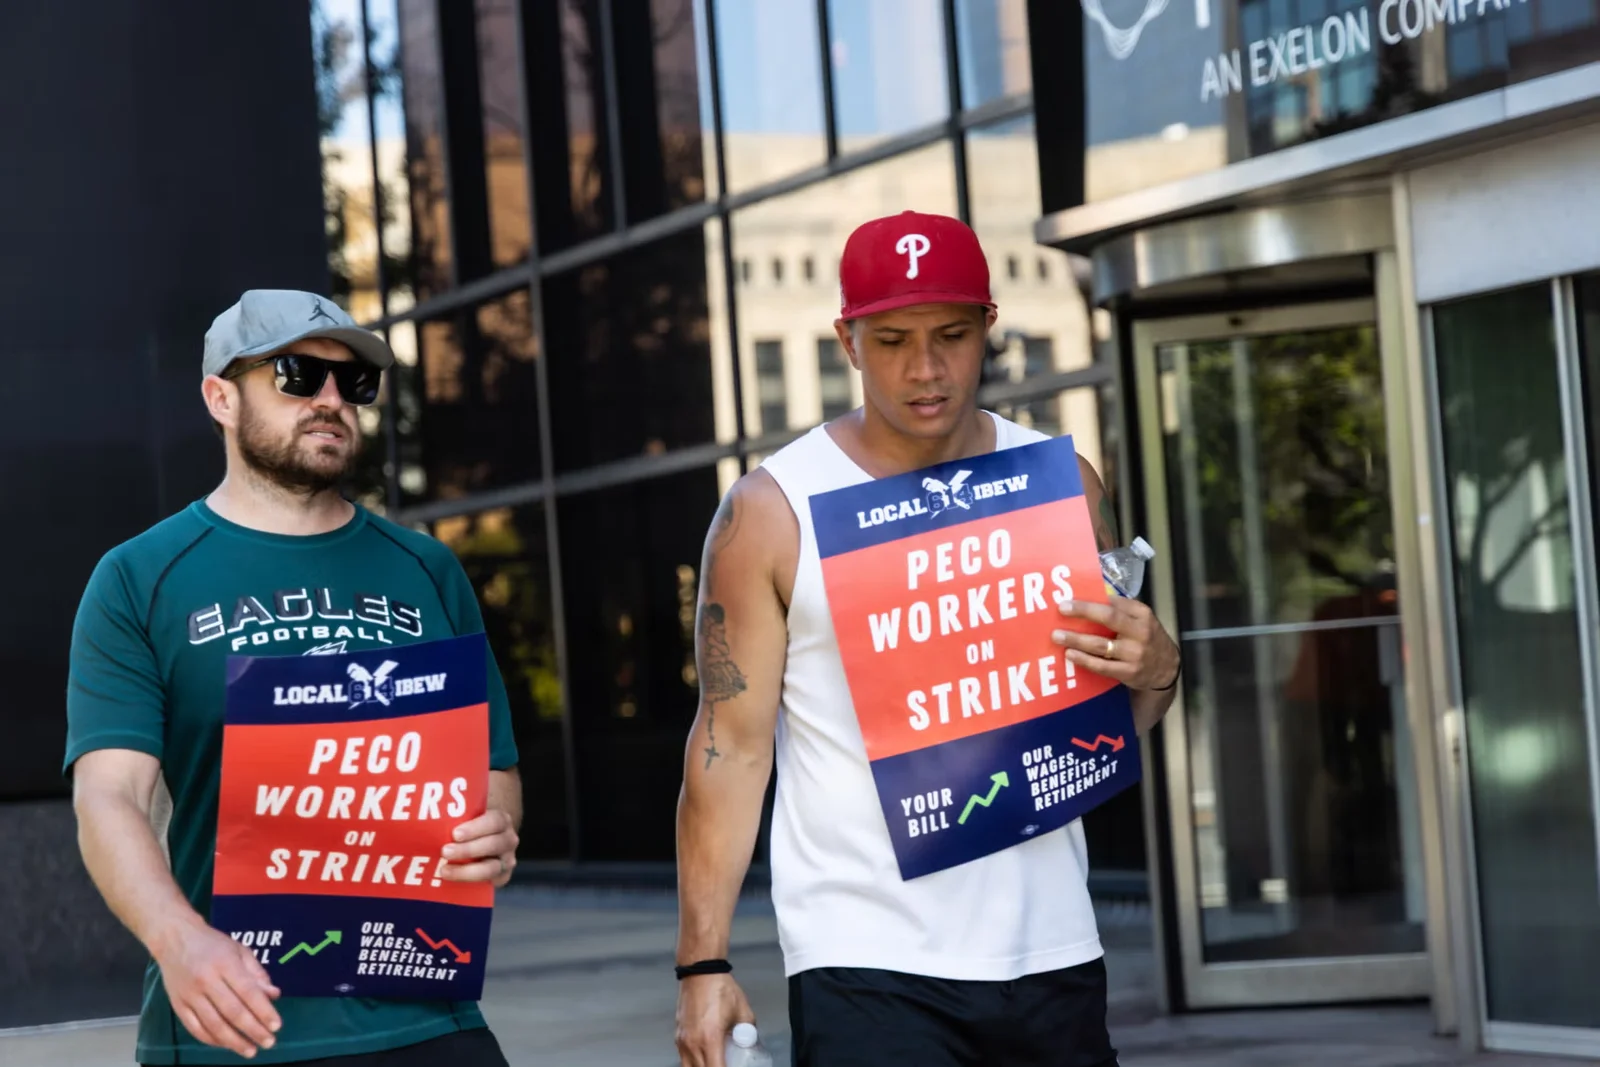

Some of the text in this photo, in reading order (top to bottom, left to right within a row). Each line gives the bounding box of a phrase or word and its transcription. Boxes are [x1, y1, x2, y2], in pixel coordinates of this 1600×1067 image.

[1200, 48, 1242, 102] AN
[1250, 11, 1371, 88] EXELON
[895, 233, 931, 280] P
[857, 497, 929, 529] LOCAL
[972, 474, 1029, 501] IBEW
[907, 528, 1012, 590] PECO
[187, 588, 423, 645] EAGLES
[868, 564, 1075, 653] WORKERS
[231, 626, 393, 651] FOOTBALL
[966, 639, 995, 664] ON
[273, 684, 349, 705] LOCAL
[394, 672, 447, 697] IBEW
[907, 655, 1078, 731] STRIKE!
[308, 732, 422, 775] PECO
[1022, 745, 1054, 767] OUR
[1026, 752, 1080, 782] WAGES,
[1030, 758, 1096, 797] BENEFITS
[1035, 760, 1118, 811] RETIREMENT
[255, 777, 467, 820] WORKERS
[901, 788, 954, 816] YOUR
[344, 831, 376, 847] ON
[908, 811, 950, 838] BILL
[266, 848, 448, 888] STRIKE!
[360, 936, 418, 951] WAGES,
[361, 922, 395, 935] OUR
[357, 963, 457, 981] RETIREMENT
[358, 949, 433, 966] BENEFITS
